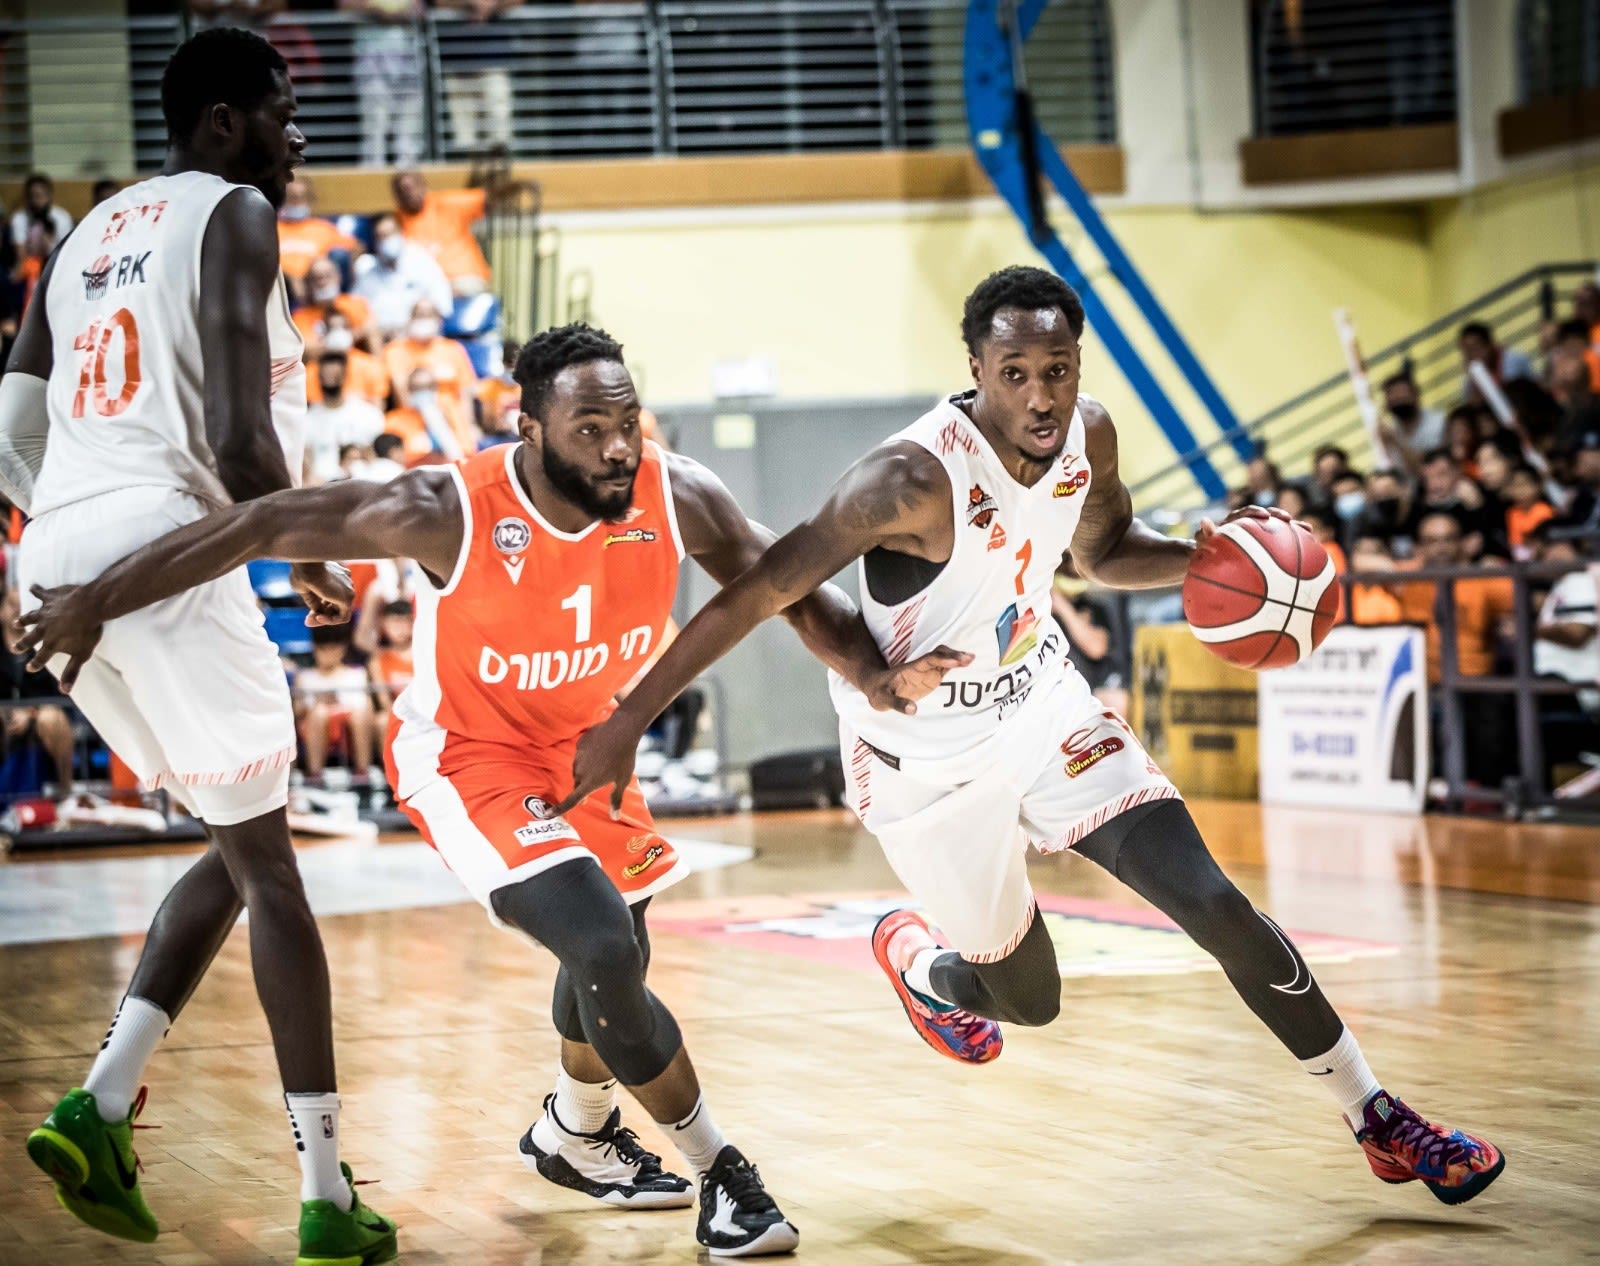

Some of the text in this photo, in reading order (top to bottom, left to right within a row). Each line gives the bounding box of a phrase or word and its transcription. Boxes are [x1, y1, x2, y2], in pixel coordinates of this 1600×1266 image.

[71, 307, 142, 419] 10
[560, 583, 593, 644] 1
[477, 624, 653, 692] חי מוטורס
